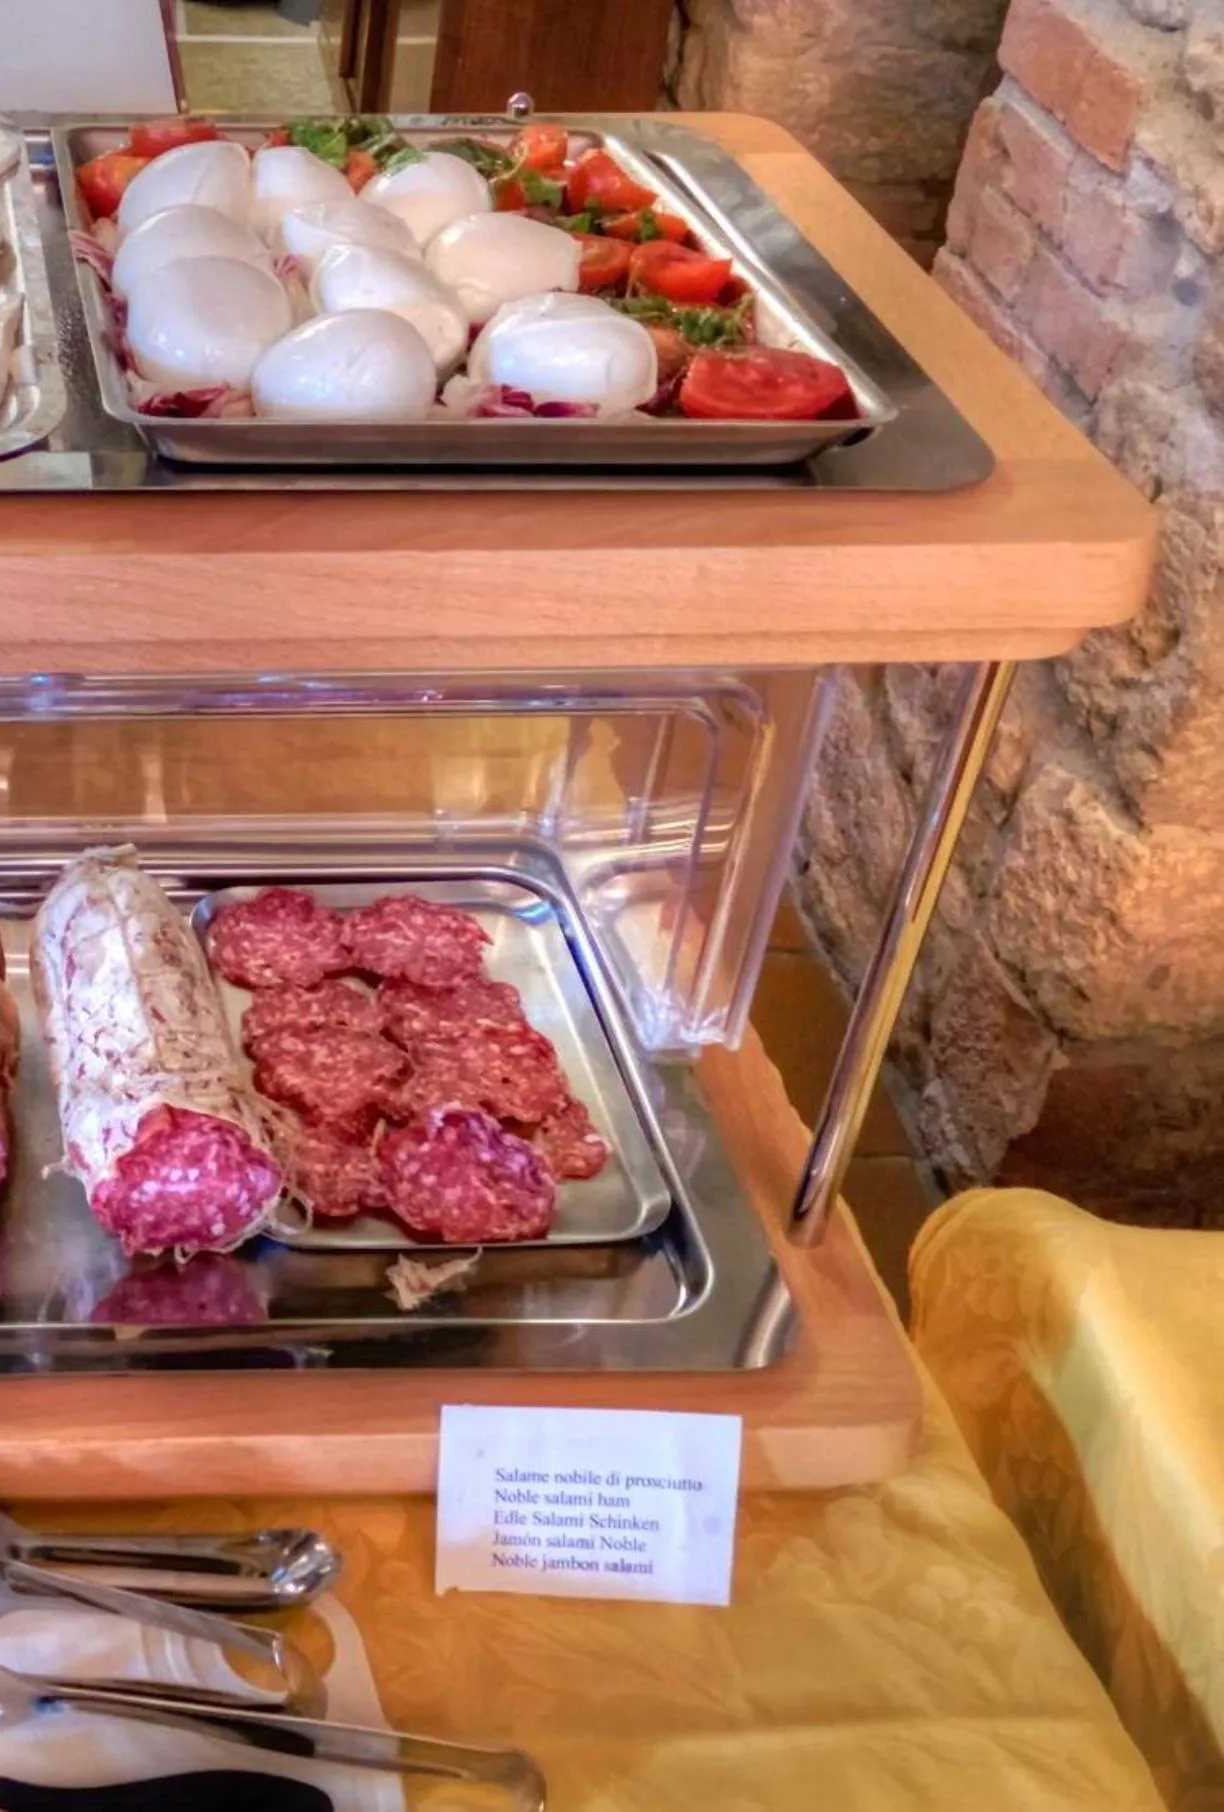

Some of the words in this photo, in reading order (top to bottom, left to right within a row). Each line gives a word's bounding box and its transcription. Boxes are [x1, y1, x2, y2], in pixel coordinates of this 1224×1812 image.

[494, 1467, 549, 1484] Salame
[554, 1470, 601, 1486] nobile
[605, 1471, 620, 1487] di
[625, 1474, 703, 1492] prosciutto
[494, 1488, 539, 1505] Noble
[544, 1490, 593, 1506] salami
[597, 1491, 631, 1508] ham
[493, 1509, 527, 1526] Edle
[532, 1510, 584, 1529] Salami
[589, 1512, 660, 1531] Schinken
[545, 1532, 595, 1550] salami
[599, 1535, 647, 1553] Noble
[492, 1552, 538, 1569] Noble
[541, 1554, 599, 1572] jambon
[603, 1557, 654, 1575] salami
